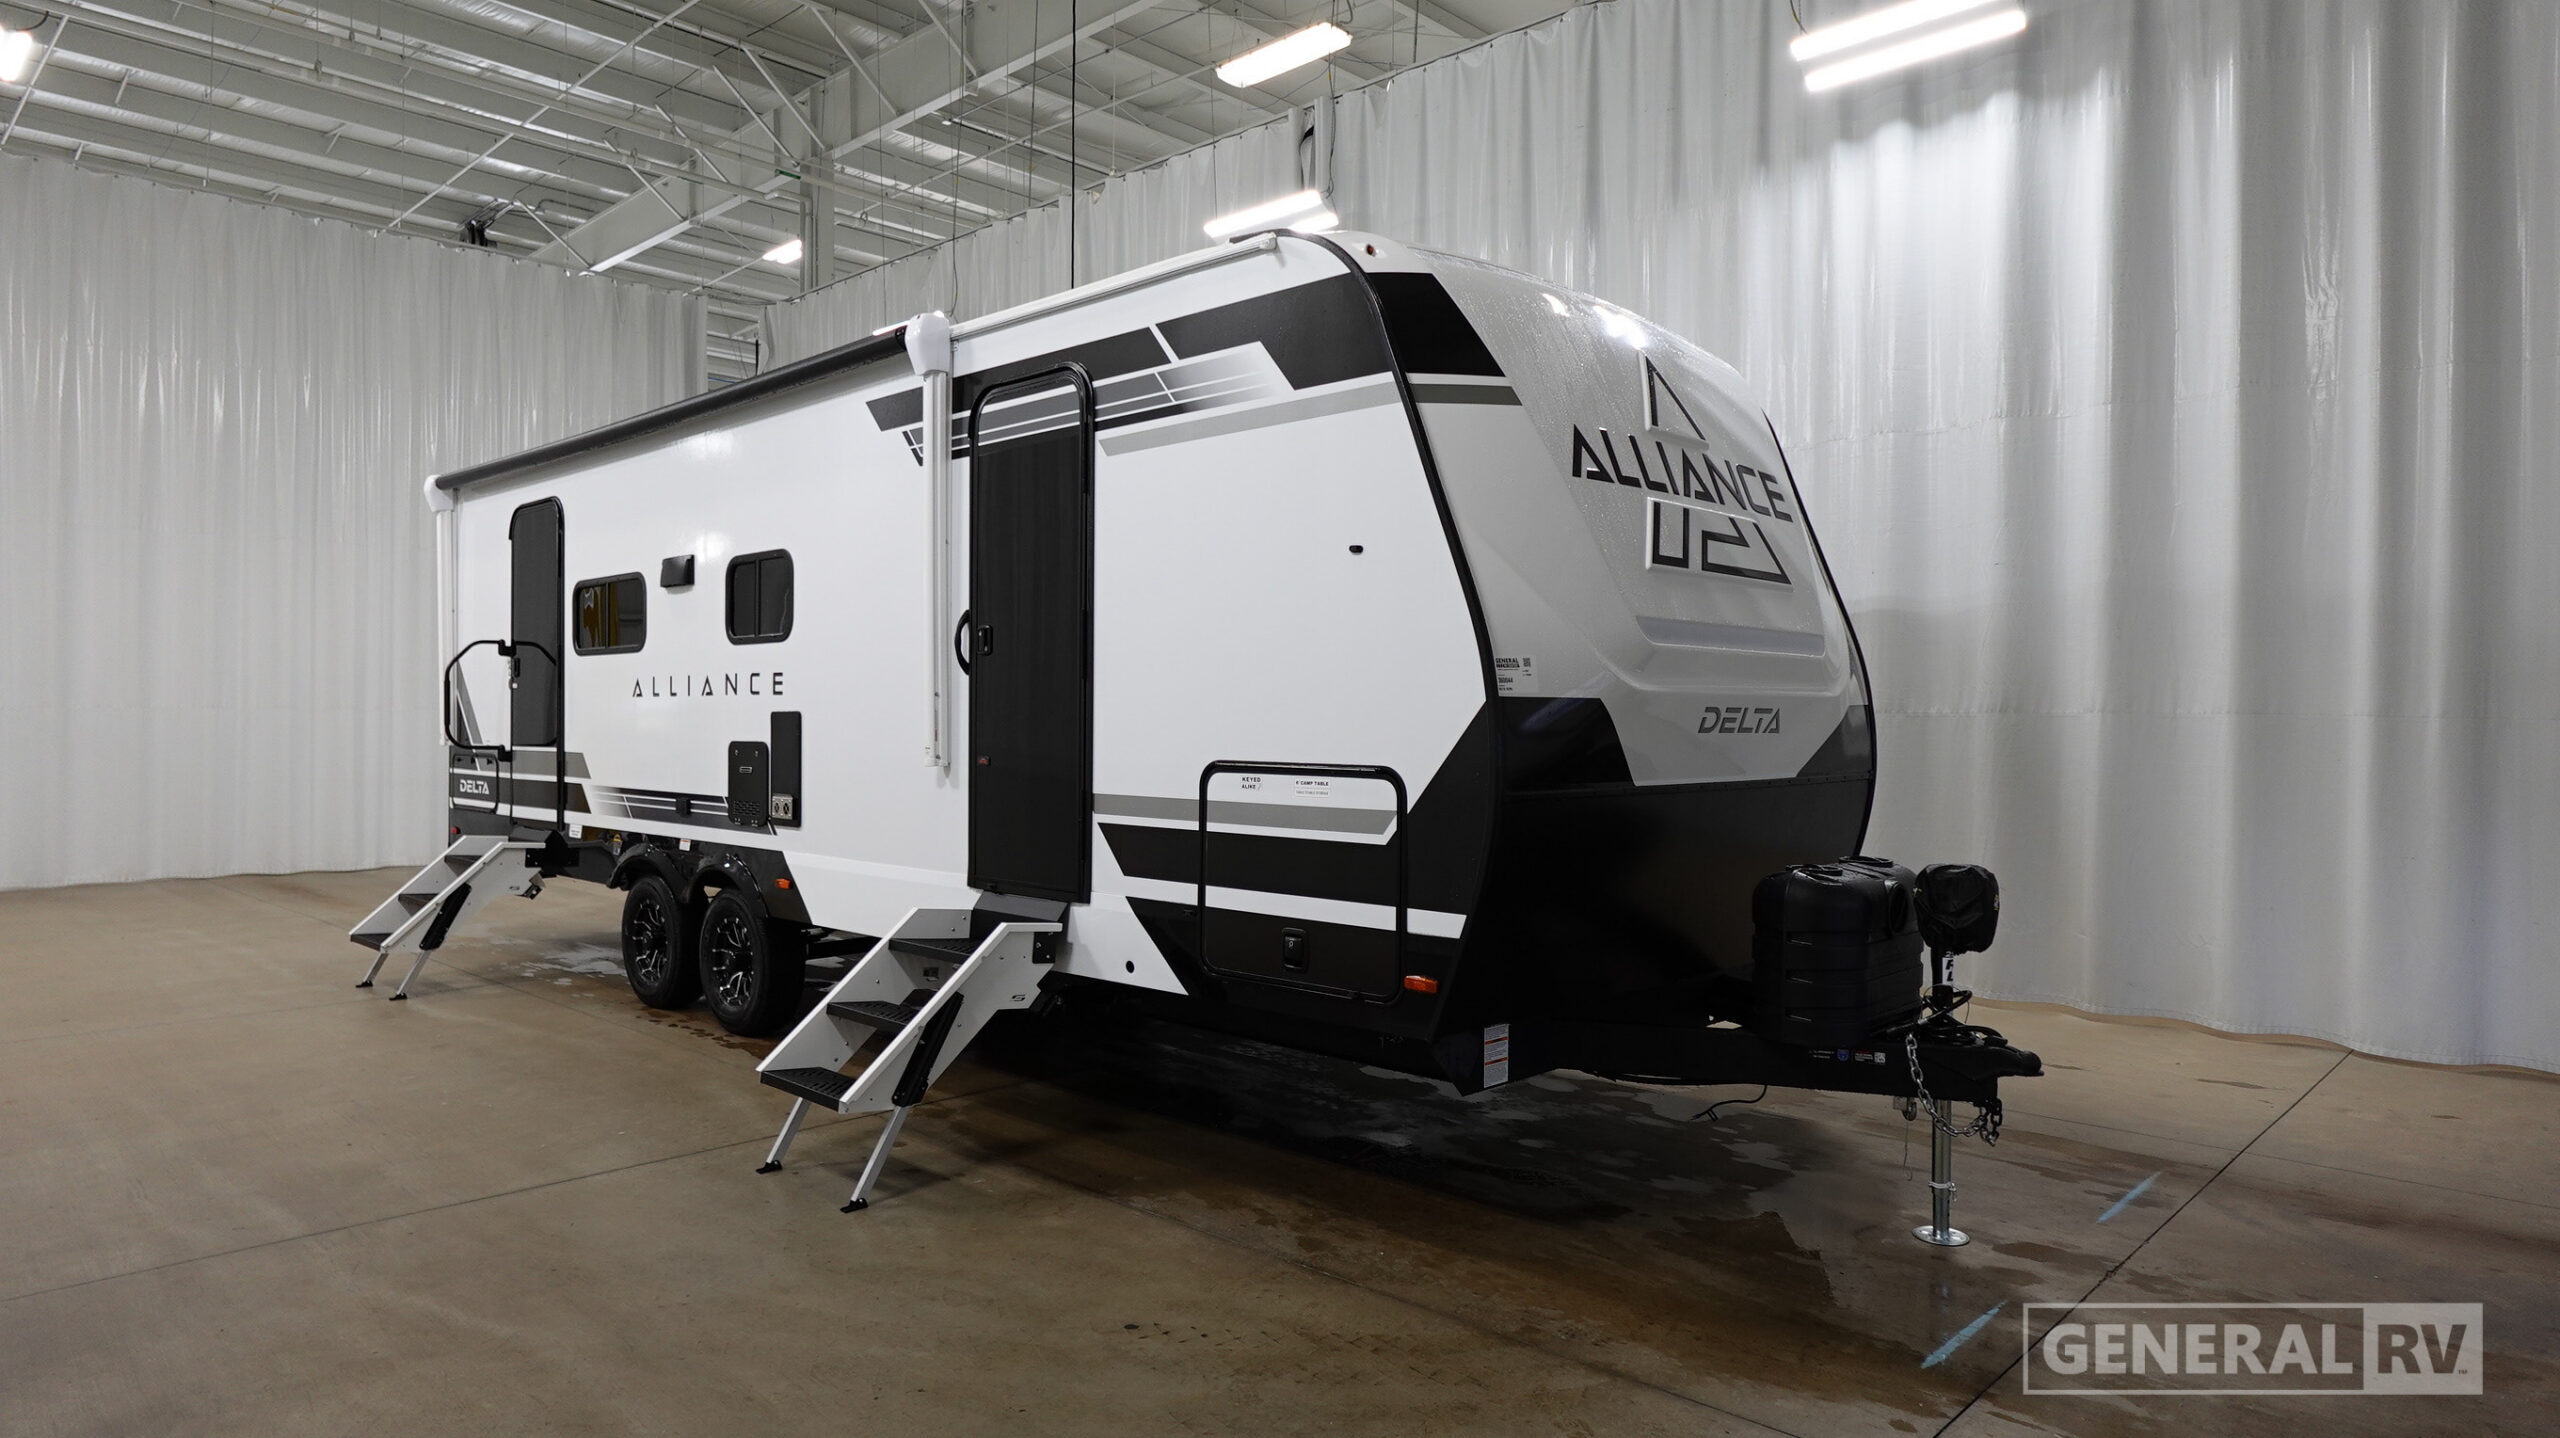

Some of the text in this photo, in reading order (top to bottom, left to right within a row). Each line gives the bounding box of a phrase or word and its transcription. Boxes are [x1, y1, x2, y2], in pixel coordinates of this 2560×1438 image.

[1571, 423, 1794, 523] ALLIANCE
[631, 672, 784, 698] ALLIANCE
[1697, 706, 1781, 734] DELTA
[459, 779, 490, 795] DELTA
